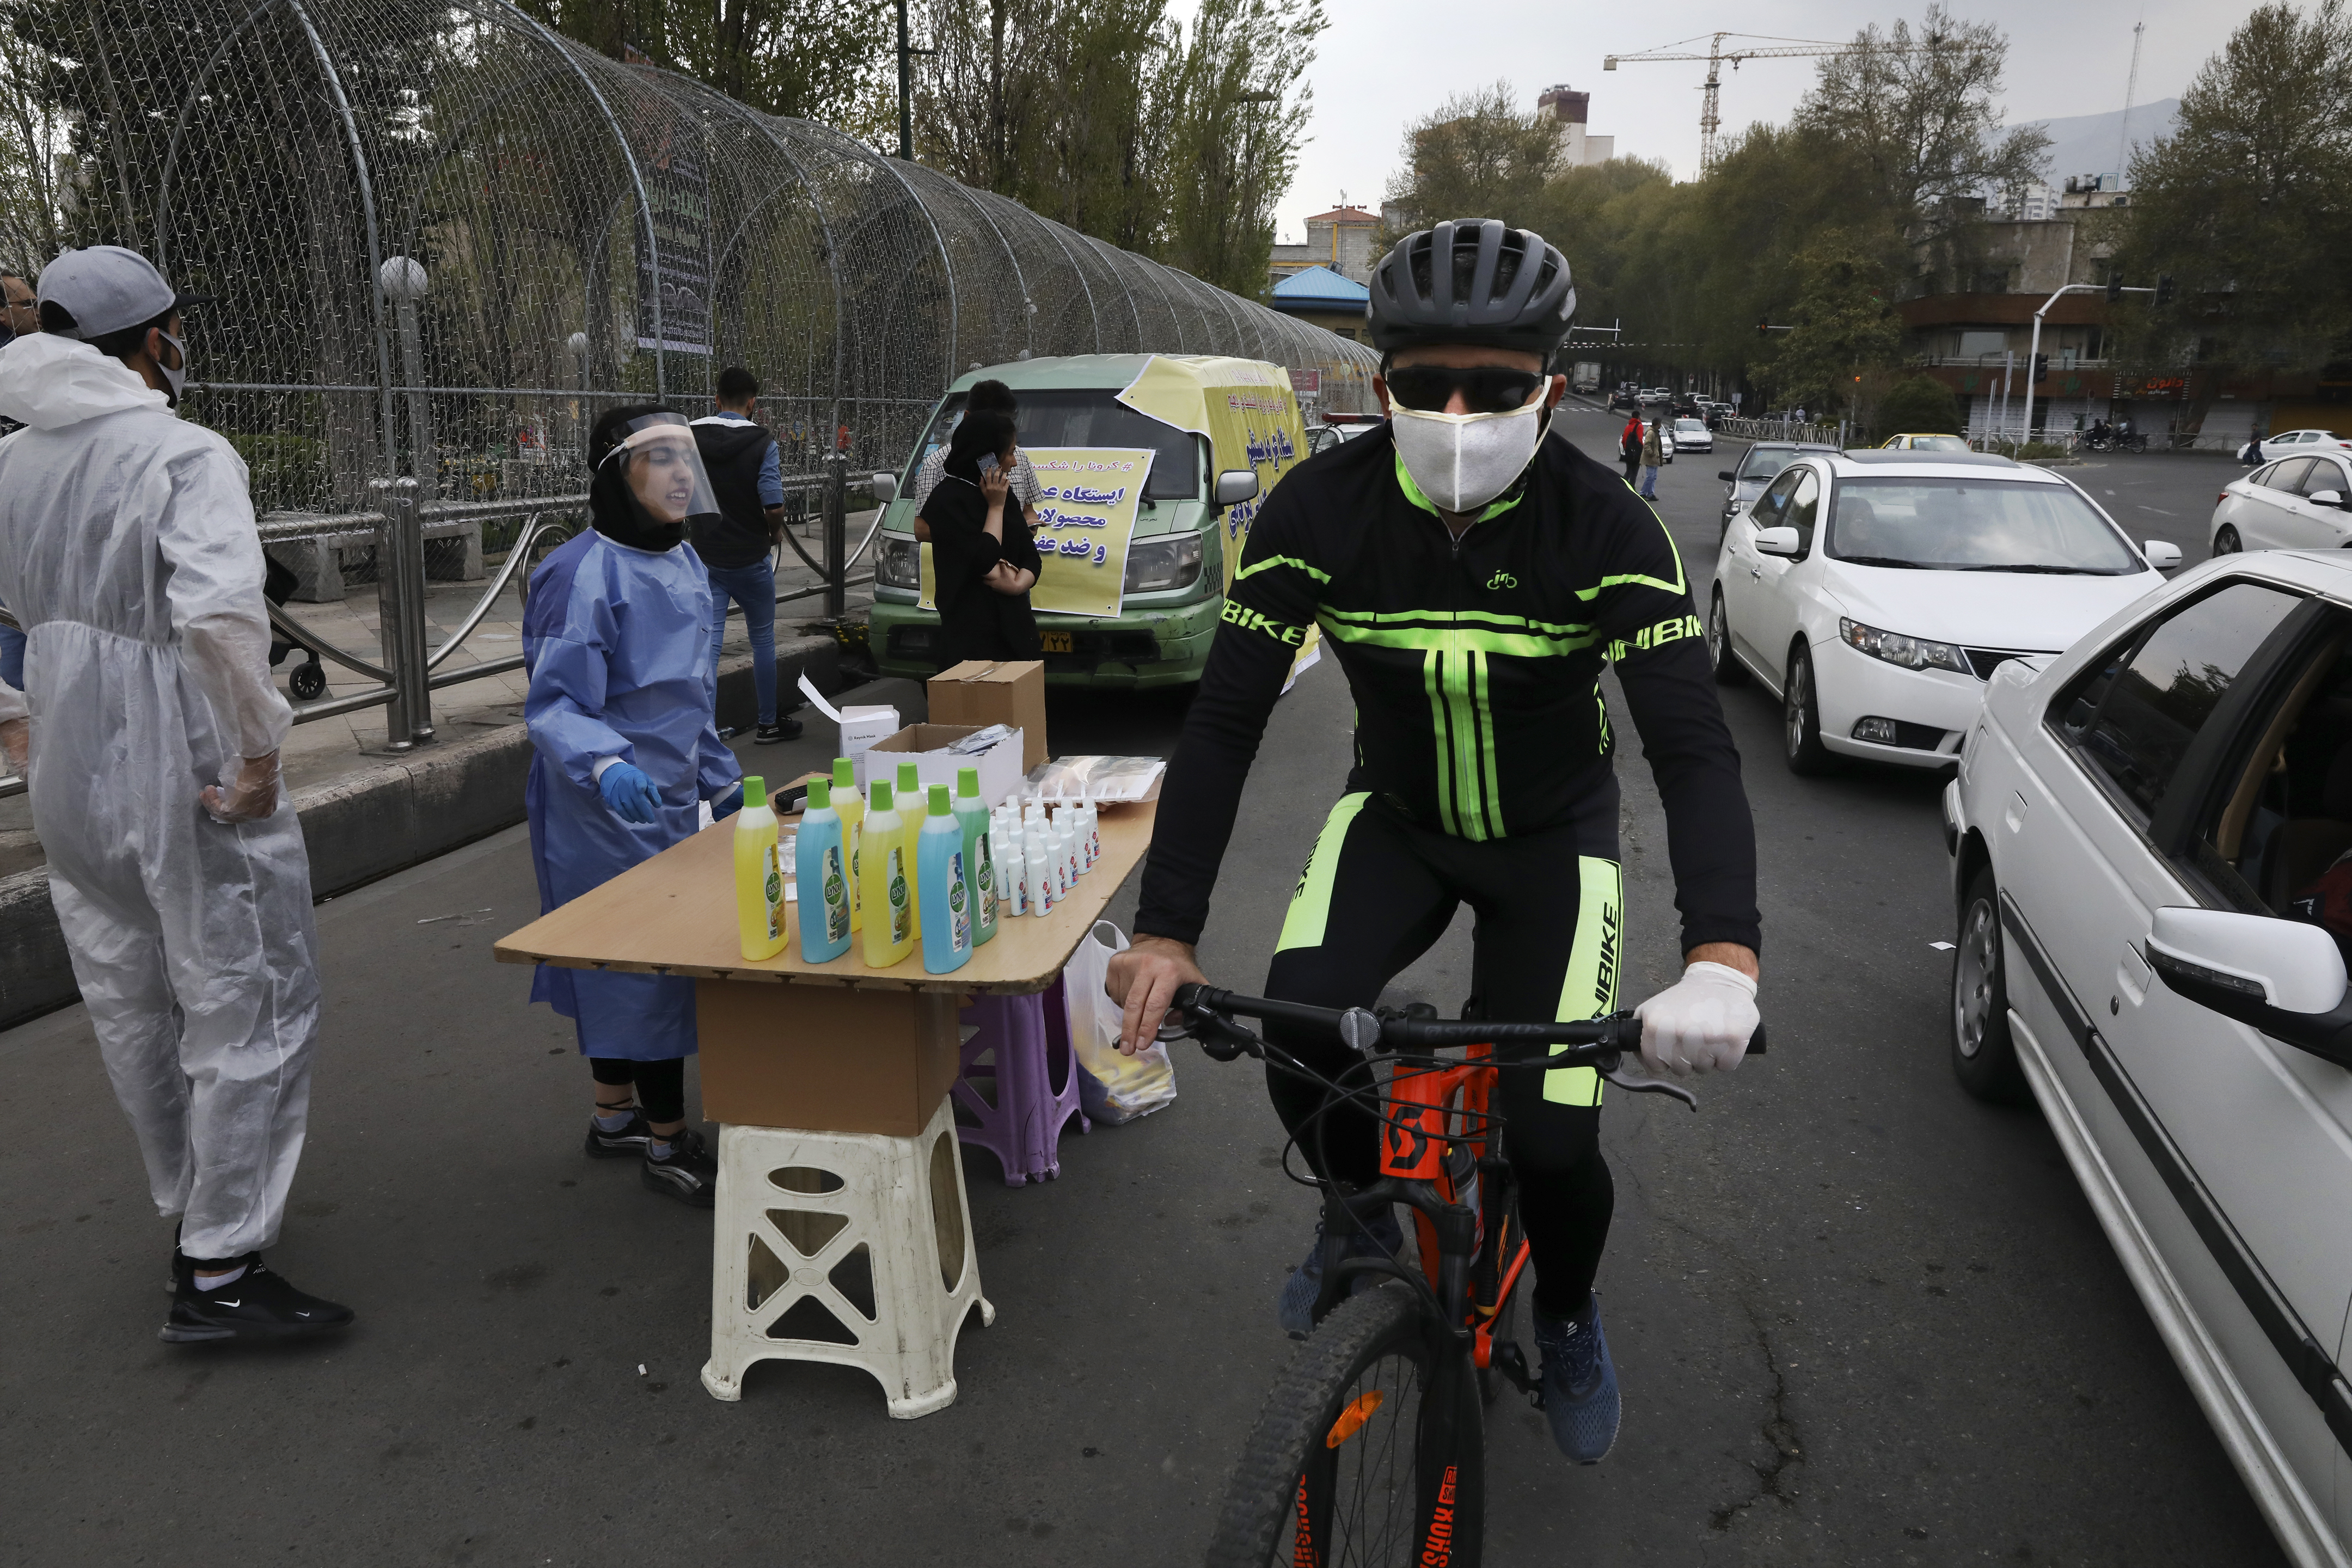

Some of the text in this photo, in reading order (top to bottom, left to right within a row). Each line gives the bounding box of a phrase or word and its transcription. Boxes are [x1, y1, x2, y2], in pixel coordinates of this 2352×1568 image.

[1031, 460, 1069, 471] شکس
[1072, 461, 1085, 471] را
[1088, 462, 1119, 471] کرونا
[1062, 486, 1125, 505] ایستگاه
[1059, 537, 1091, 554] ضد
[1092, 544, 1106, 562] و
[1220, 598, 1307, 646] BIKE
[979, 872, 991, 885] LYNX
[768, 880, 780, 896] LYNX
[826, 882, 841, 898] LYNX
[891, 883, 905, 899] LYNX
[952, 889, 964, 905] LYNX
[1419, 1506, 1454, 1568] SHOX
